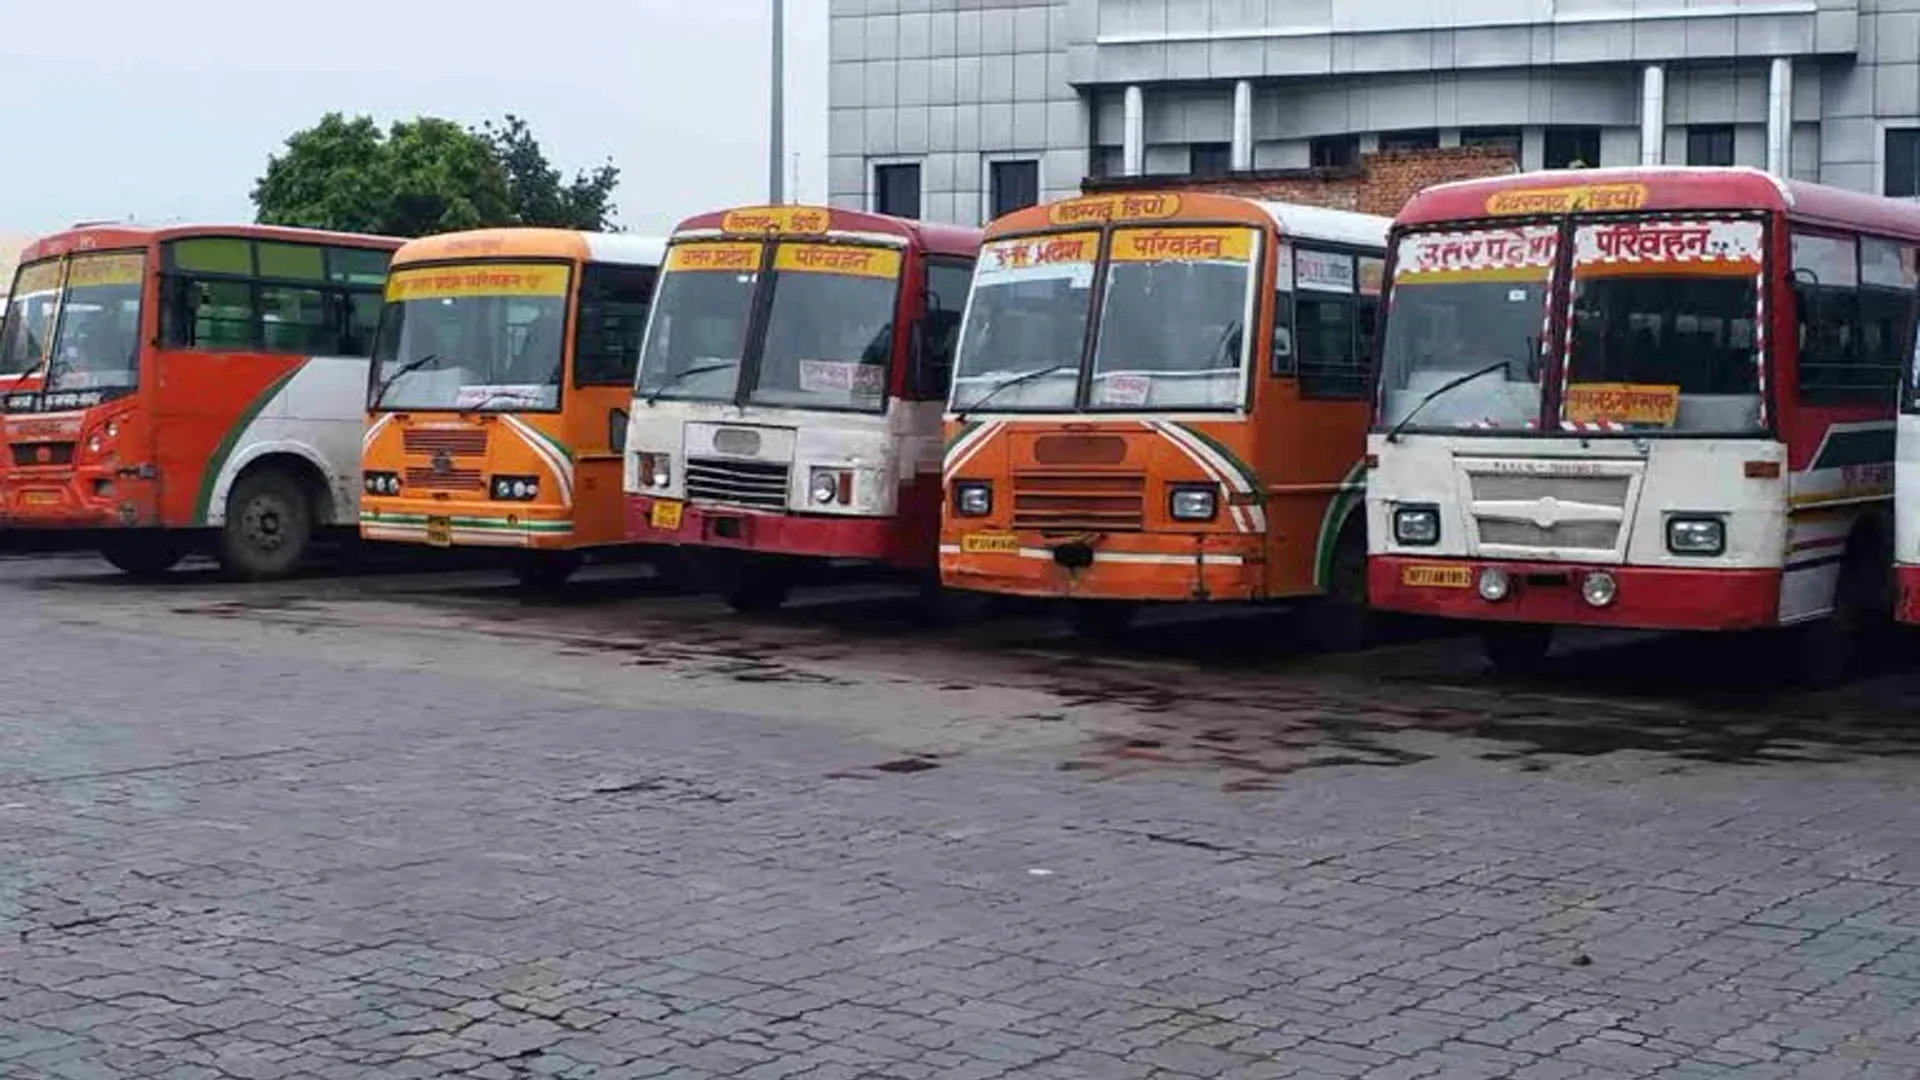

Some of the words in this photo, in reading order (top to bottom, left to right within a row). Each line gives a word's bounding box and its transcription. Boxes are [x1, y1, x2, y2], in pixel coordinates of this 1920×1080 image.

[1121, 195, 1166, 217] डिपो
[1132, 230, 1224, 258] परिवहन
[1595, 222, 1712, 260] परिवहन
[795, 247, 873, 272] परिवहन
